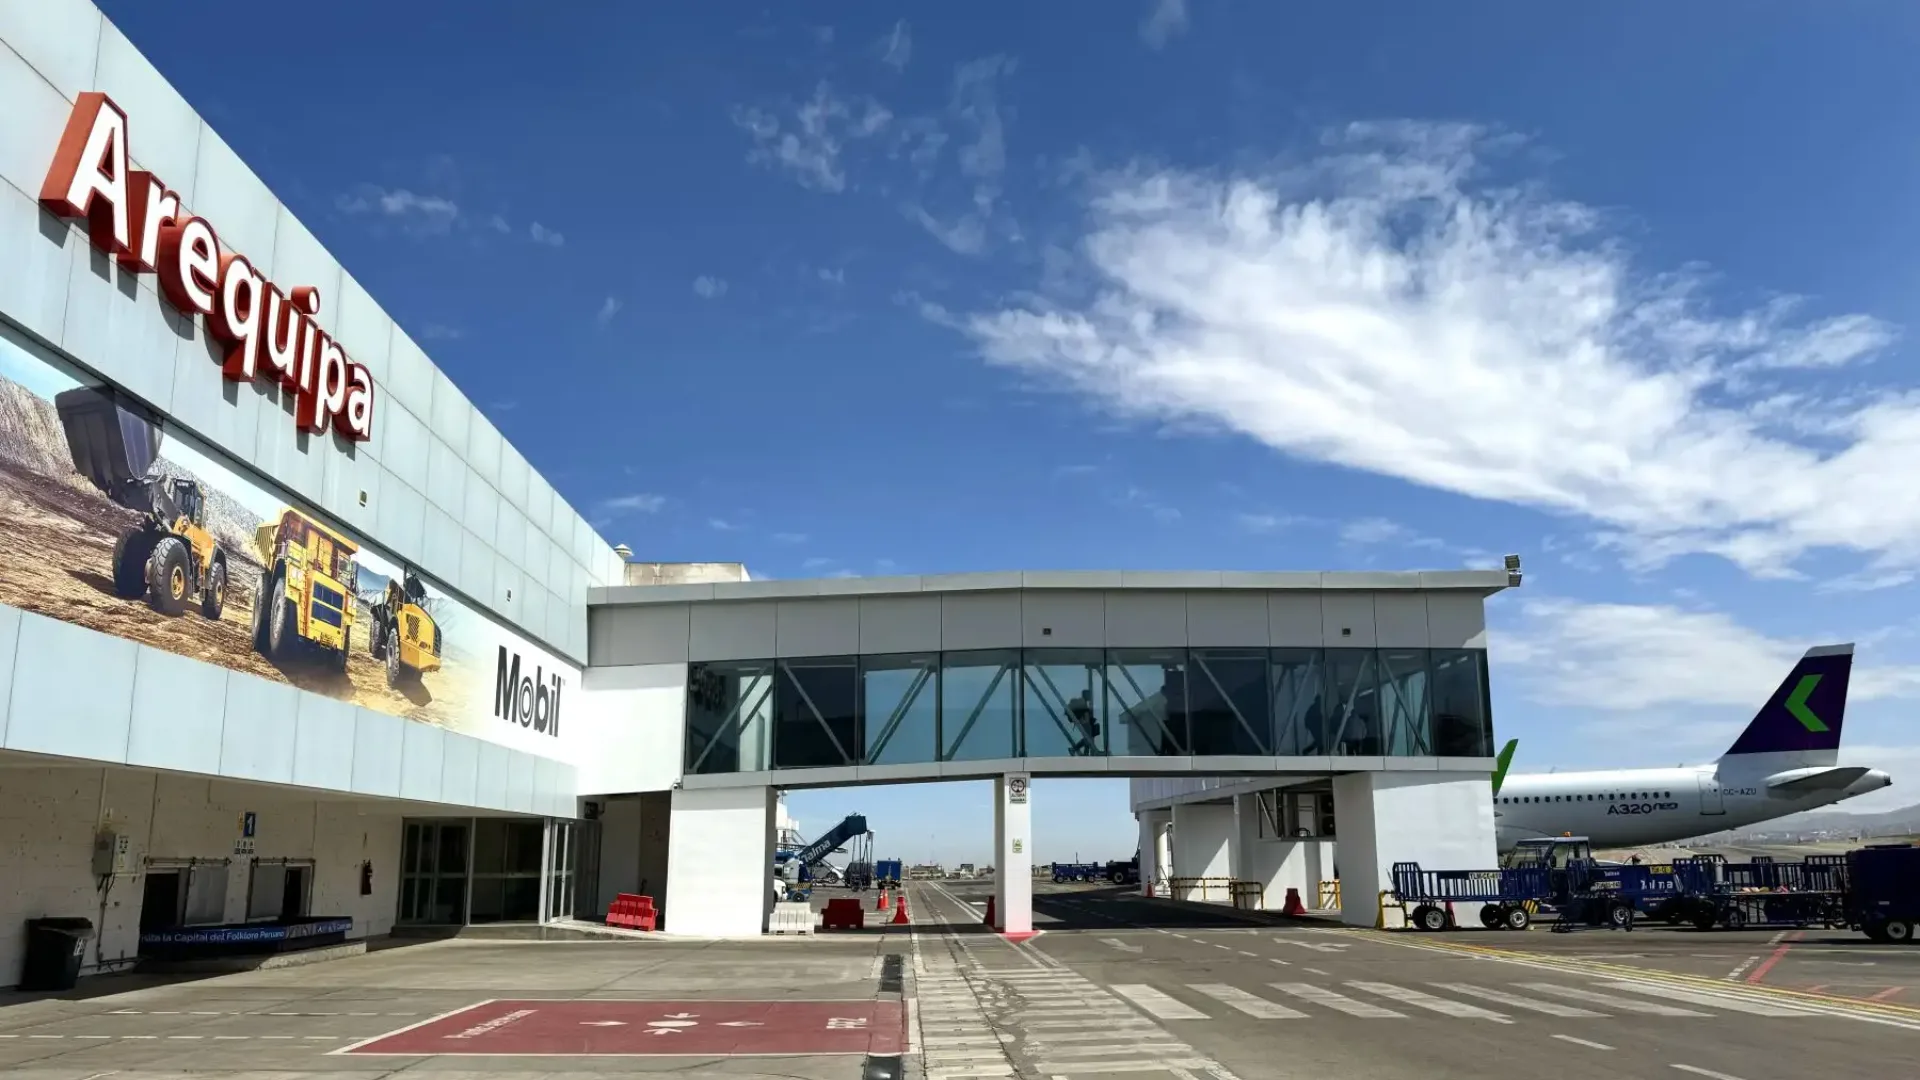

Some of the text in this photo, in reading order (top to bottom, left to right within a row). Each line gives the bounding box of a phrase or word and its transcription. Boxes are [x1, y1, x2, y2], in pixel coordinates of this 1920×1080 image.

[38, 92, 373, 442] Arequipa
[494, 644, 562, 738] Mobil
[174, 932, 208, 944] Capital
[209, 931, 226, 942] del
[226, 930, 259, 941] Folklore
[259, 929, 285, 939] Peruano
